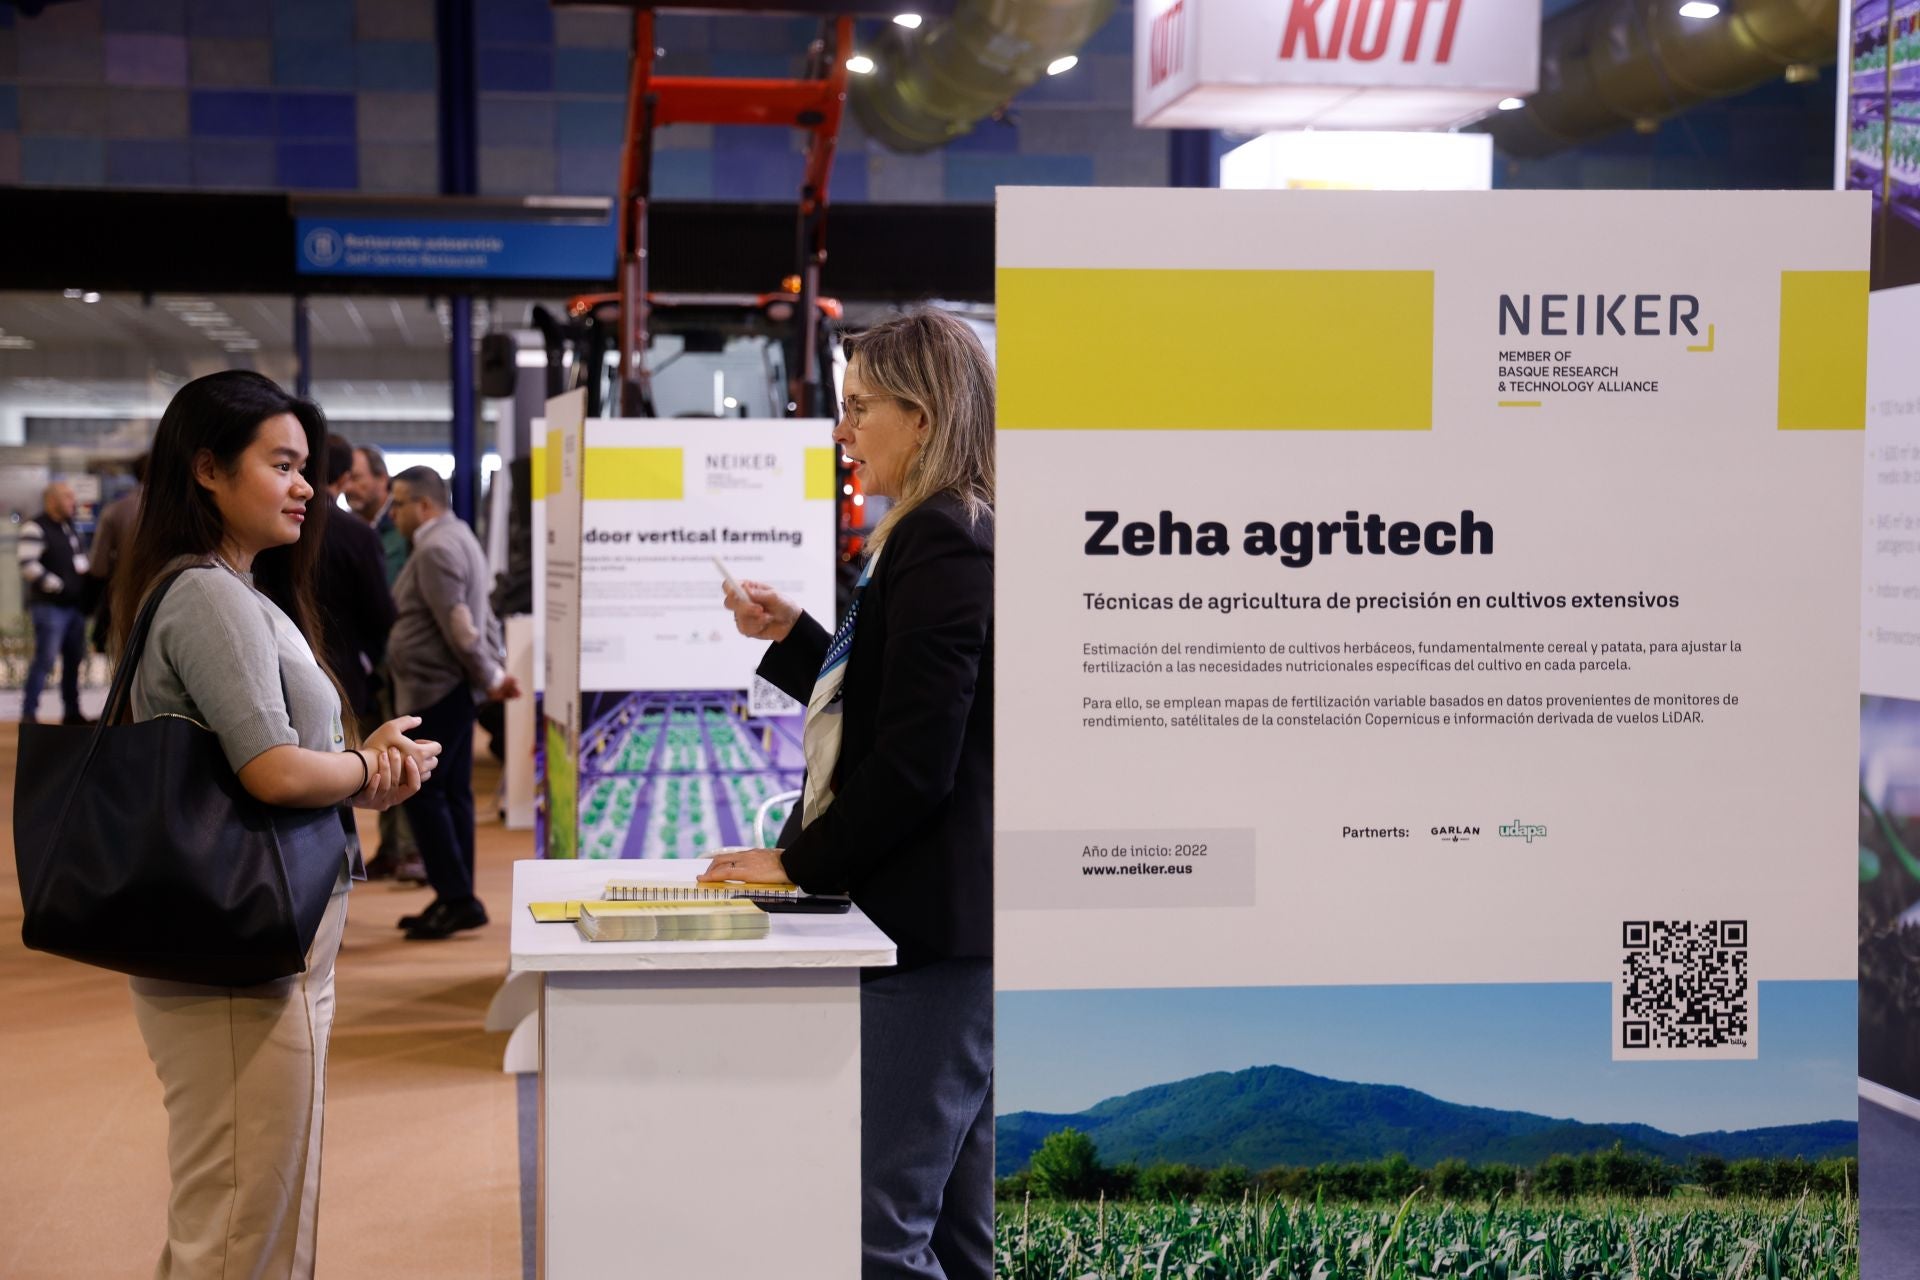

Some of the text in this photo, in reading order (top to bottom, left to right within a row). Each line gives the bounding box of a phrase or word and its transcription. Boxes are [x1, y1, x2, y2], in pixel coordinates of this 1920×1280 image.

[1498, 293, 1700, 336] NEIKER
[1498, 350, 1572, 362] MEMBER OF
[1498, 366, 1619, 378] BASQUE RESEARCH
[1497, 380, 1659, 393] & TECHNOLOGY ALLIANCE
[706, 453, 777, 470] NEIKER
[583, 528, 803, 546] door vertical farming
[1084, 509, 1494, 569] Zeha agritech
[1082, 590, 1680, 614] Técnicas de agricultura de precisión en cultivos extensivos
[1083, 639, 1742, 656] Estimación del rendimiento de cultivos herbáceos, fundamentalmente cereal y patata, para ajustar la
[1082, 657, 1631, 675] fertilización a las necesidades nutricionales específicas del cultivo en cada parcela.
[1083, 693, 1739, 712] Para ello, se emplean mapas de fertilización variable basados en datos provenientes de monitores de
[1082, 710, 1704, 728] rendimiento, satélitales de la constelación Copernicus e información derivada de vuelos LiDAR.
[1342, 825, 1410, 839] Partnerts:
[1430, 825, 1481, 837] GARLAN
[1499, 819, 1547, 843] udapa
[1082, 843, 1208, 858] Año de inicio: 2022
[1082, 862, 1193, 876] www.neiker.eus
